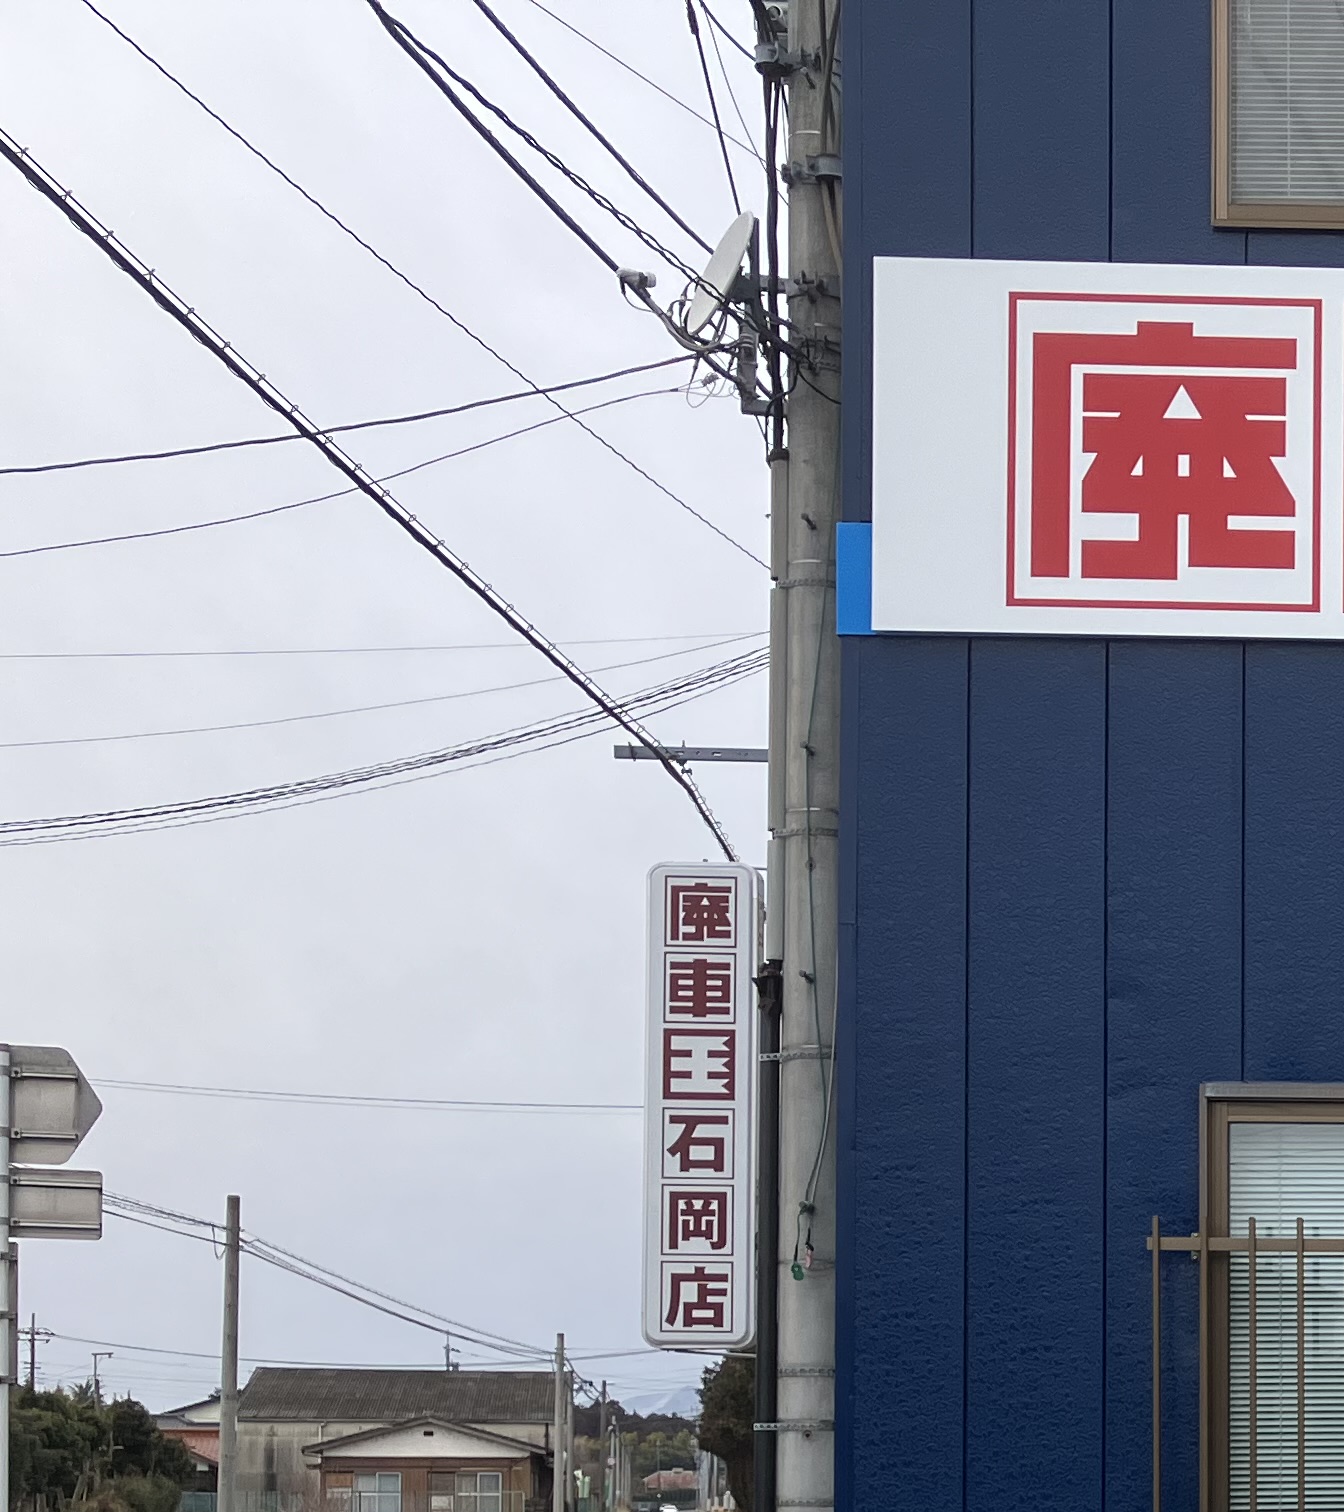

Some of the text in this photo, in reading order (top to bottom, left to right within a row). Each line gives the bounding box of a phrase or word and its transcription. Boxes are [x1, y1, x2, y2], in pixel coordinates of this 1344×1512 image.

[663, 883, 734, 1328] 廃車王石岡店
